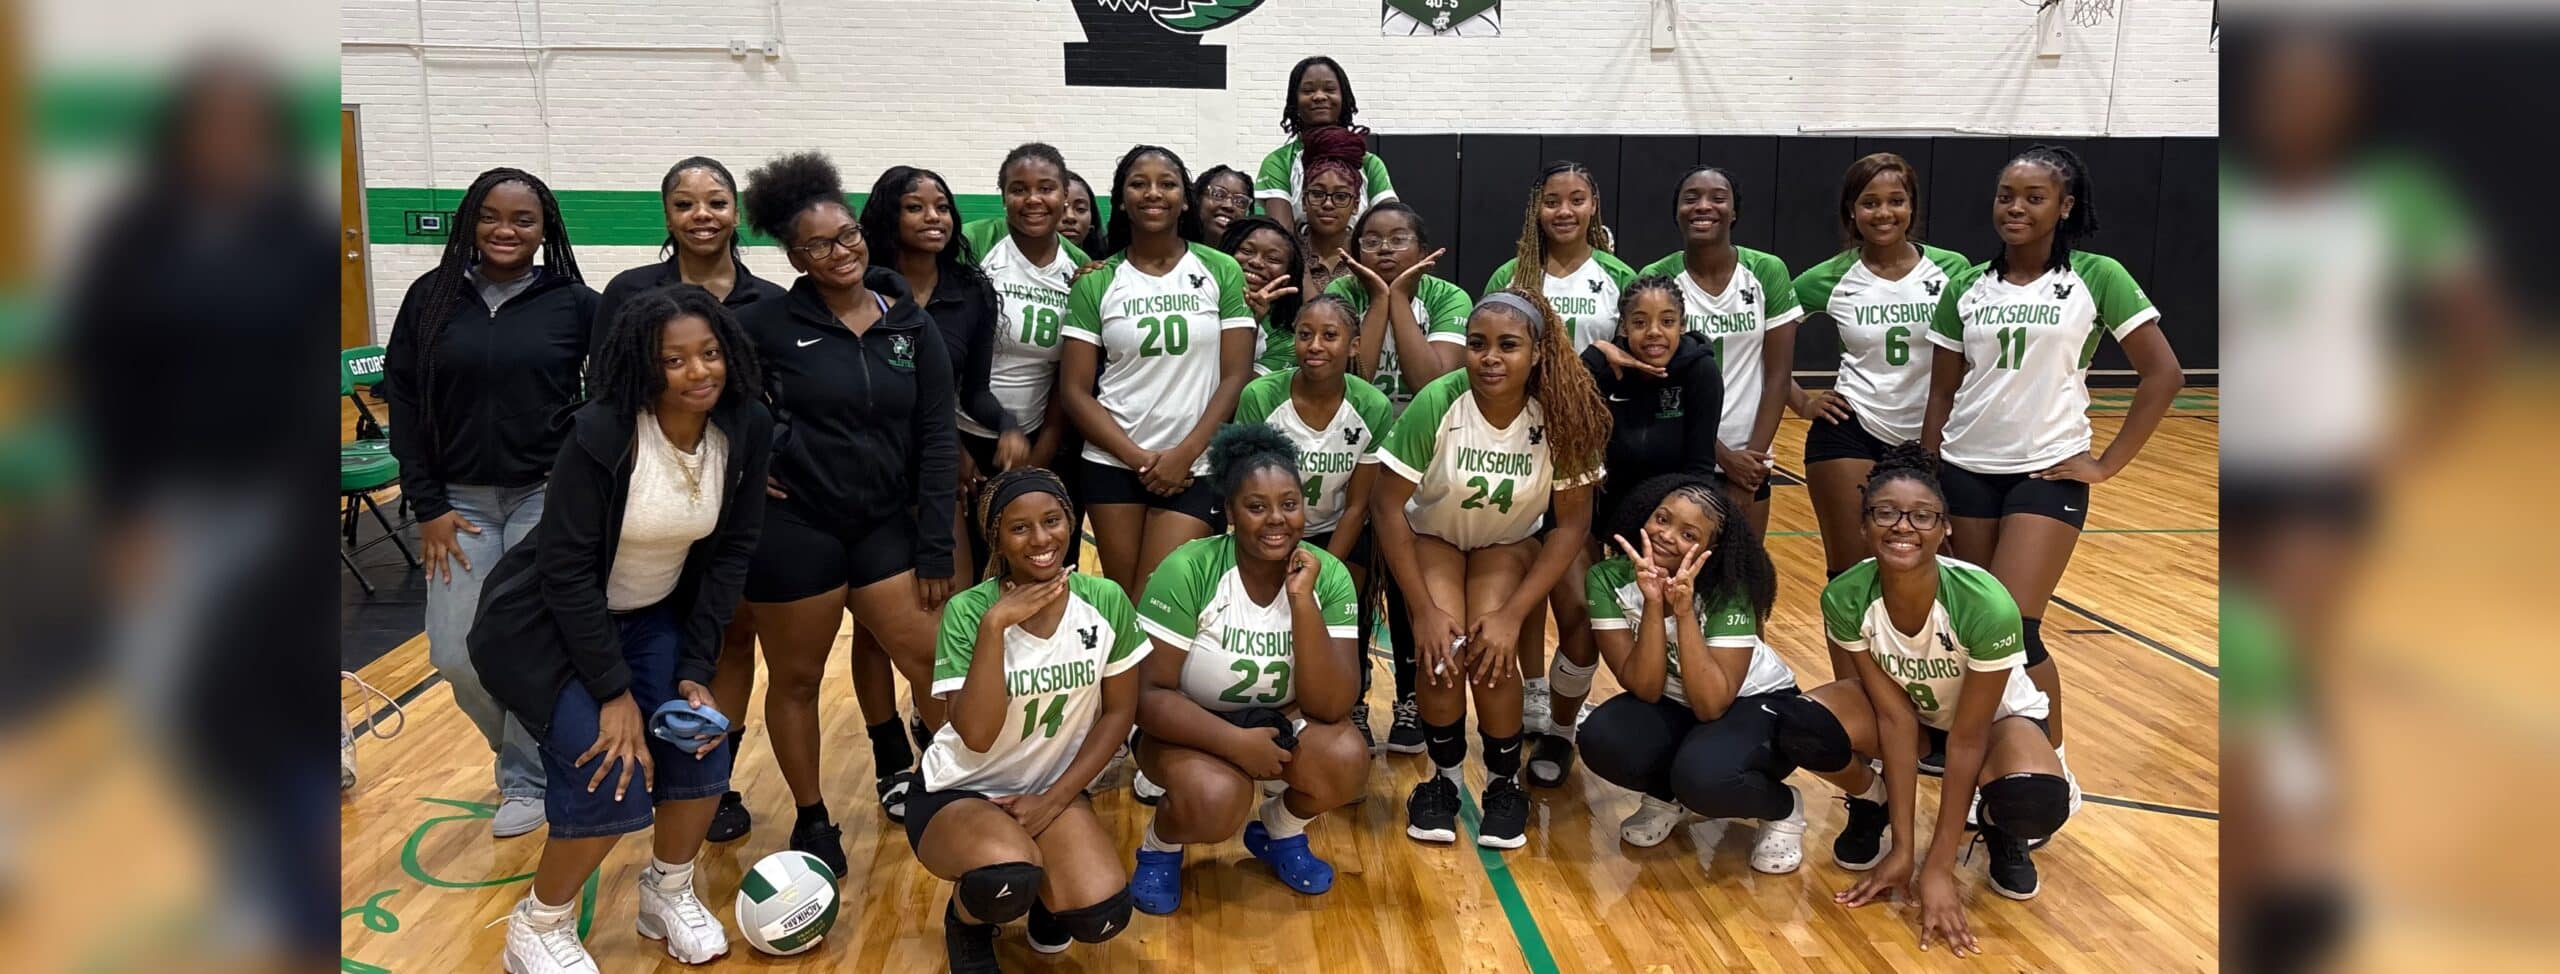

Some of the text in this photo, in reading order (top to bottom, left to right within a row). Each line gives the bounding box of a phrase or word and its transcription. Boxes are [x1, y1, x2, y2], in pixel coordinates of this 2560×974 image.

[1003, 282, 1069, 309] VICKSBUR
[1123, 294, 1200, 317] VICKSBURG
[1548, 296, 1596, 315] SBURG
[1021, 304, 1060, 348] 18
[1975, 304, 2061, 326] VICKSBURG
[1137, 314, 1188, 358] 20
[1886, 326, 1911, 366] 6
[1996, 327, 2027, 371] 11
[1298, 451, 1354, 473] KSBURG
[1457, 446, 1534, 477] VICKSBURG
[1461, 476, 1515, 514] 24
[1221, 625, 1293, 656] VICKSBU
[1219, 658, 1291, 703] 23
[1021, 694, 1069, 741] 14
